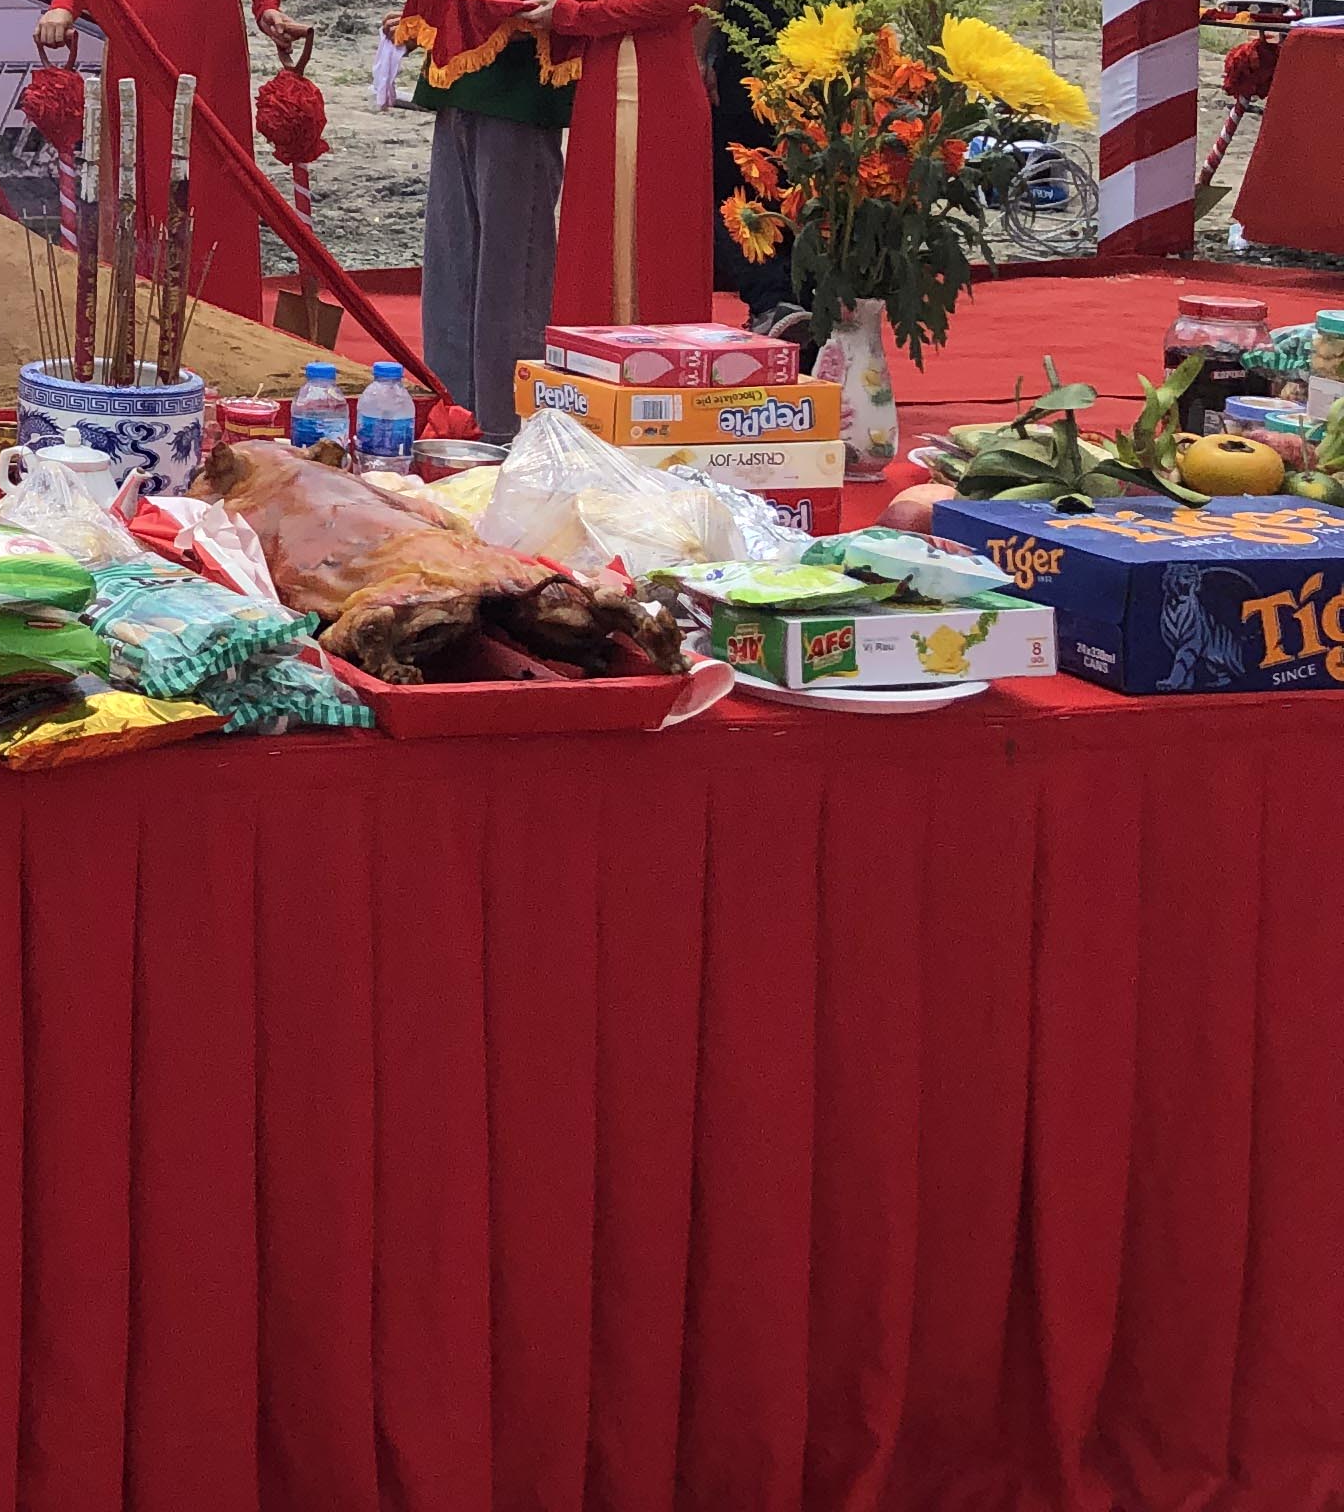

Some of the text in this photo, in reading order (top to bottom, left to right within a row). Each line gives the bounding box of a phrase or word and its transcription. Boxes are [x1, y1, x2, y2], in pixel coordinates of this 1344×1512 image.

[534, 380, 589, 416] PepPie
[713, 389, 763, 406] Chocolate
[720, 397, 813, 437] PepPie
[707, 451, 786, 467] CRISPY-JOY
[986, 535, 1064, 590] Tiger
[807, 627, 853, 657] AFC
[1031, 641, 1042, 656] 8
[1272, 663, 1318, 686] SINCE
